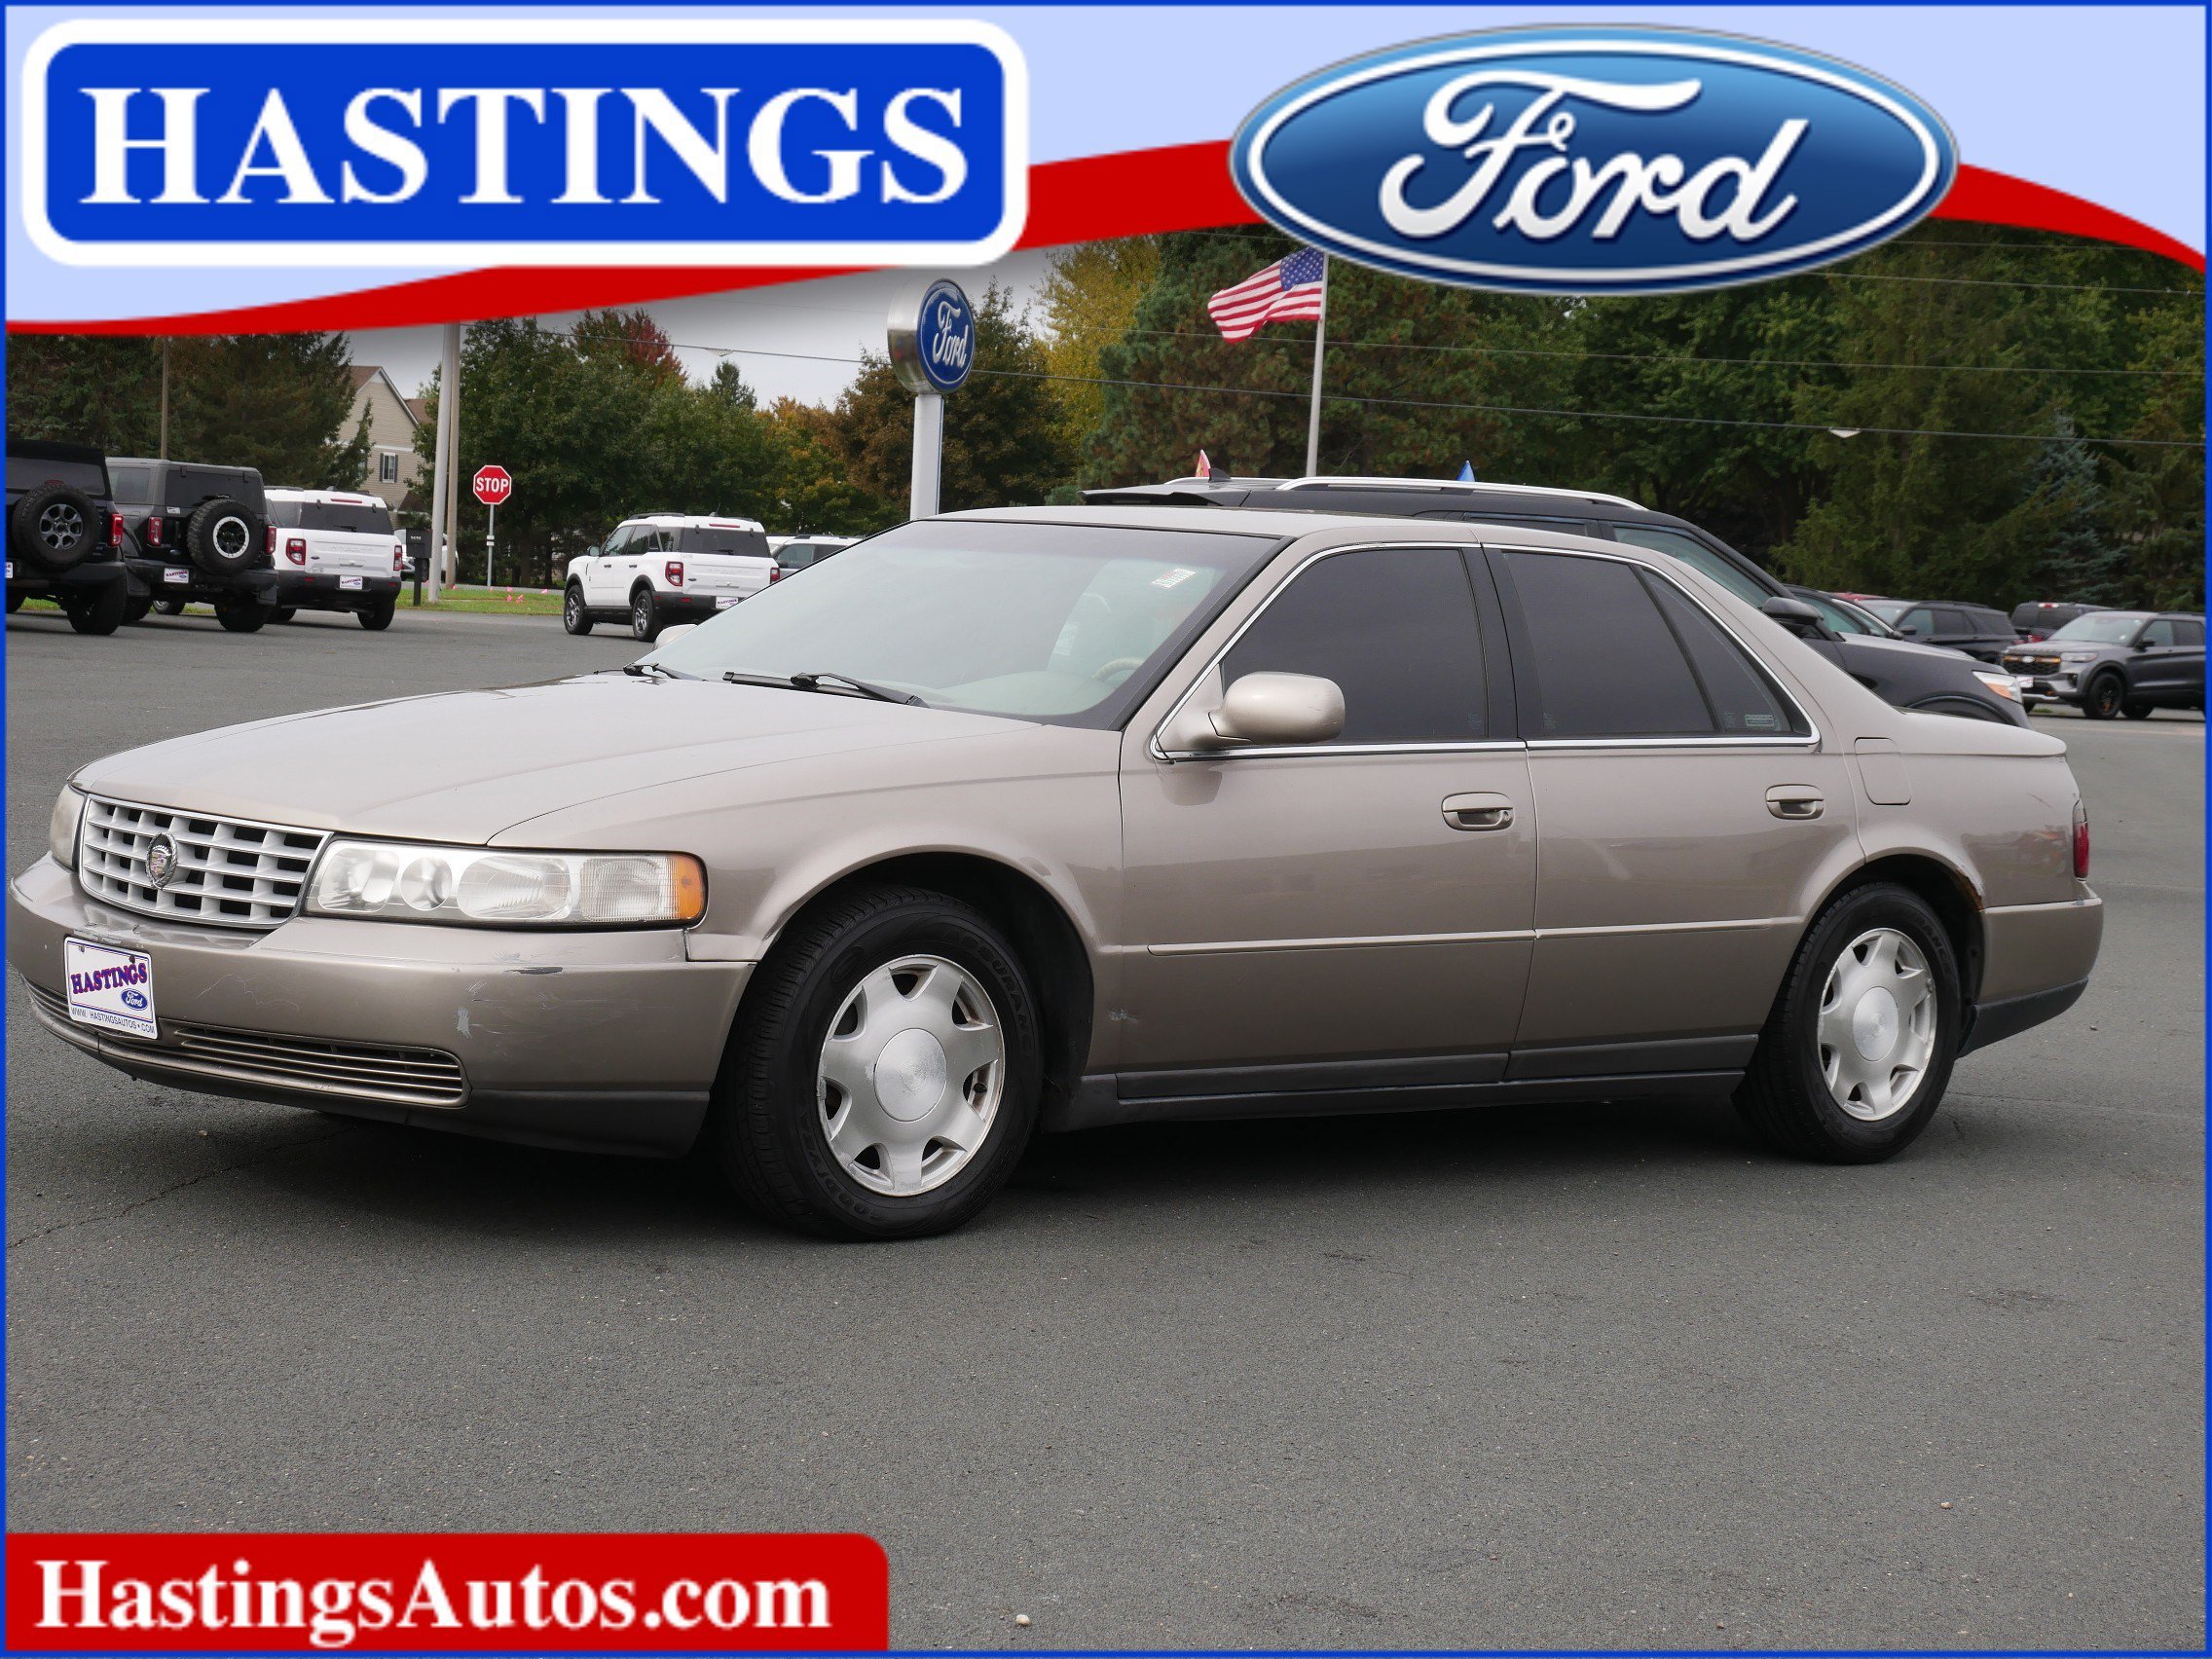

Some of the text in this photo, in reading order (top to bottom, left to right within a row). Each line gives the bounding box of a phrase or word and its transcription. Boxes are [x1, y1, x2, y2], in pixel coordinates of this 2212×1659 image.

[933, 300, 969, 369] Ford
[476, 477, 509, 493] STOP
[70, 962, 148, 994] HASTINGS
[125, 990, 143, 1007] Ford
